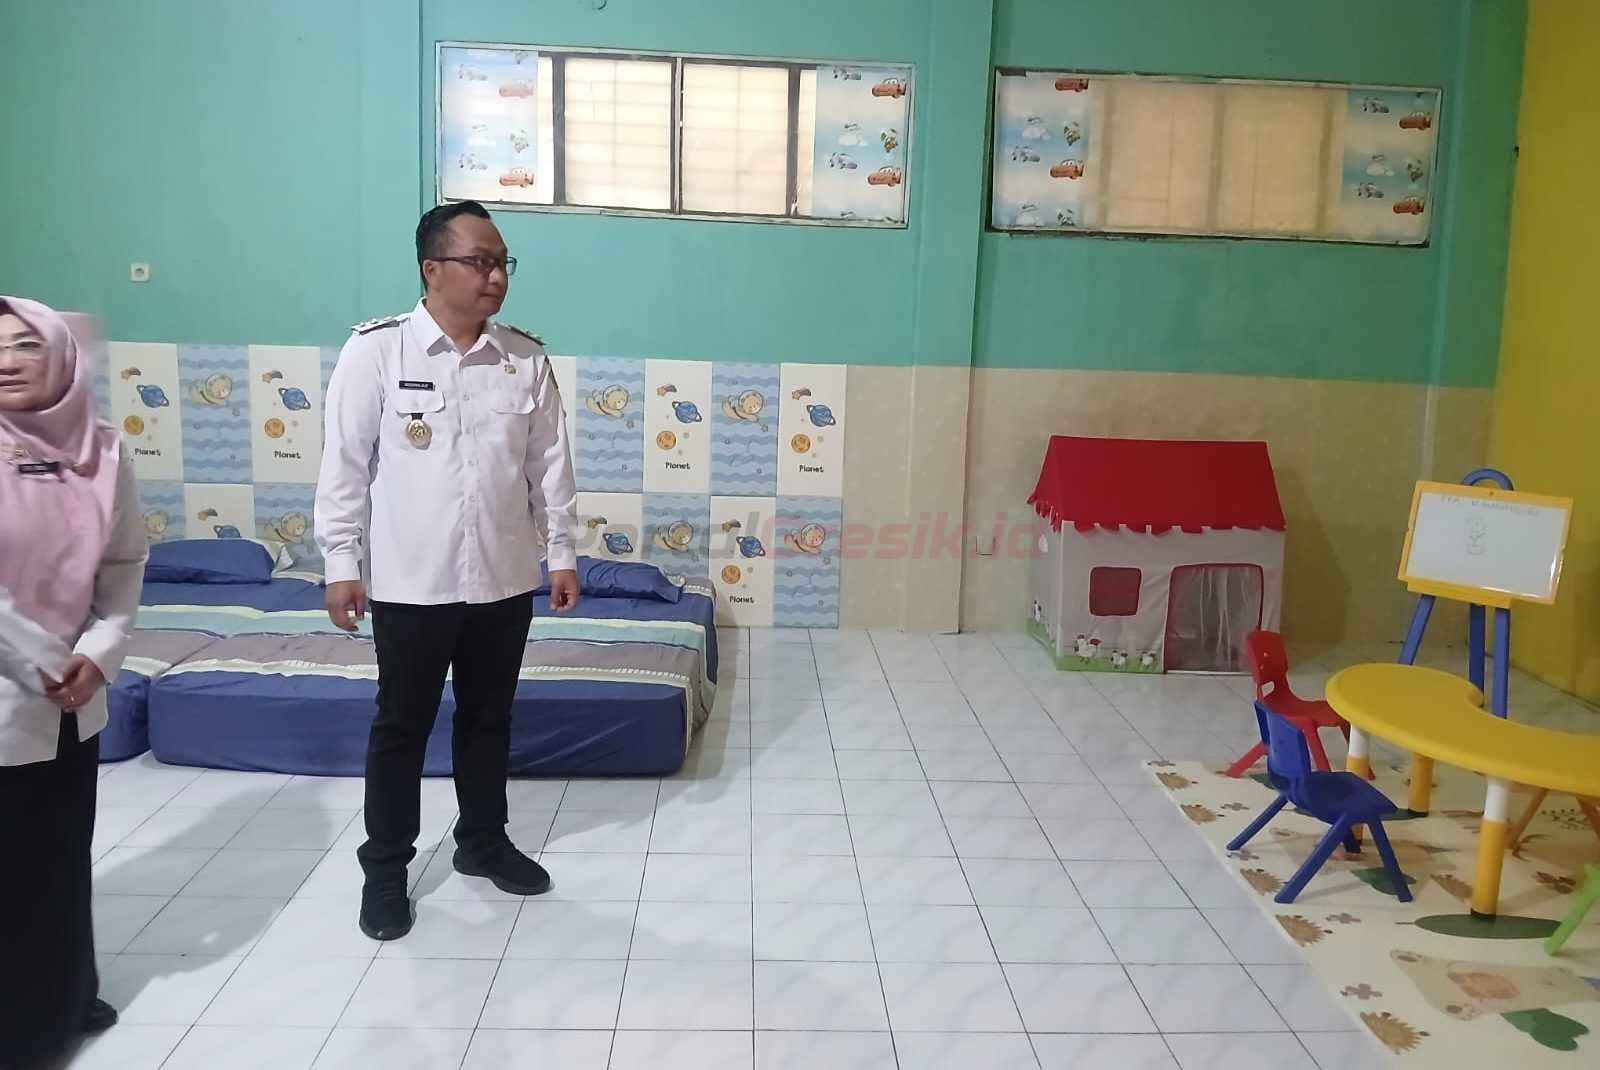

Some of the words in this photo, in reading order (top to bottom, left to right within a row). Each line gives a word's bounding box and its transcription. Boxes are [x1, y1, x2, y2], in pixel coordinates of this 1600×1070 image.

[134, 447, 161, 457] Planet
[274, 450, 301, 460] Planet
[665, 461, 691, 471] Planet
[799, 464, 825, 474] Planet
[729, 595, 755, 605] Planet
